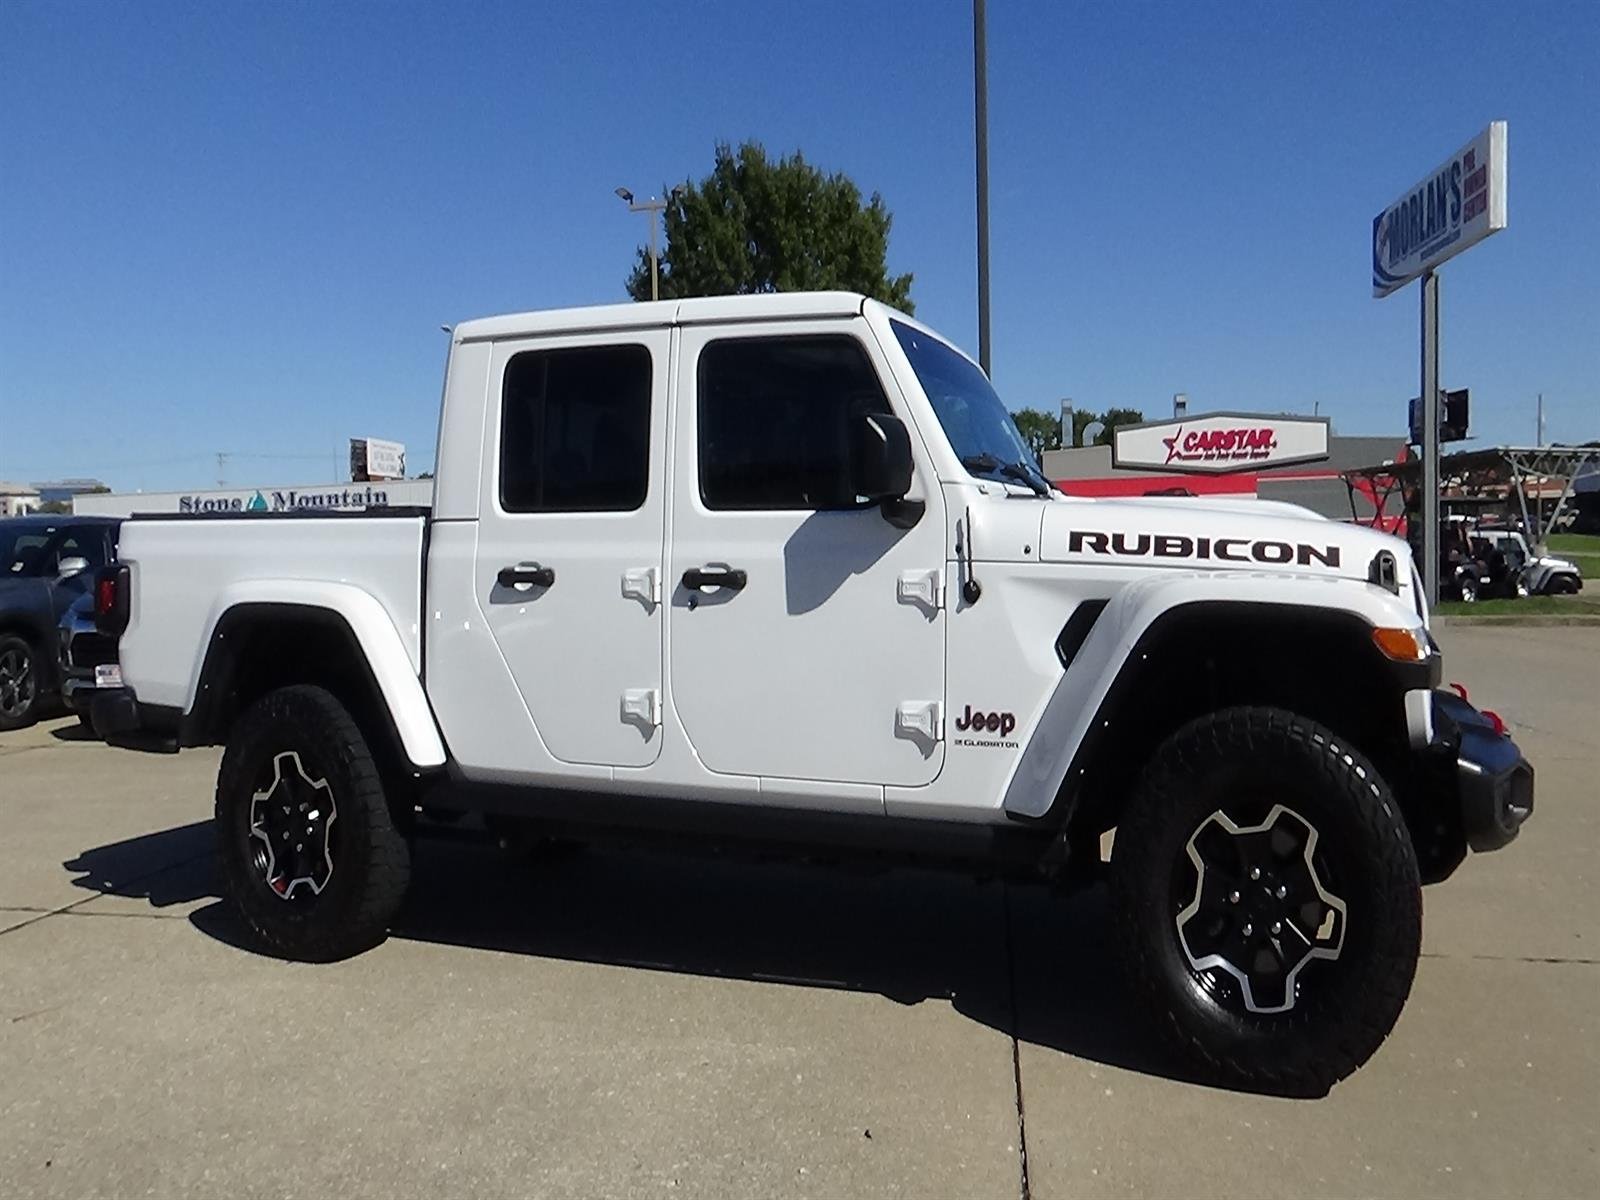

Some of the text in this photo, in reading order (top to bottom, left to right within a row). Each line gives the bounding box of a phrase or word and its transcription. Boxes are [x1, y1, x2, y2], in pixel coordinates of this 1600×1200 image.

[1183, 428, 1274, 452] CARSTAR
[178, 486, 389, 513] Stone Mountain
[1068, 531, 1341, 568] RUBICON
[955, 704, 1016, 738] Jeep
